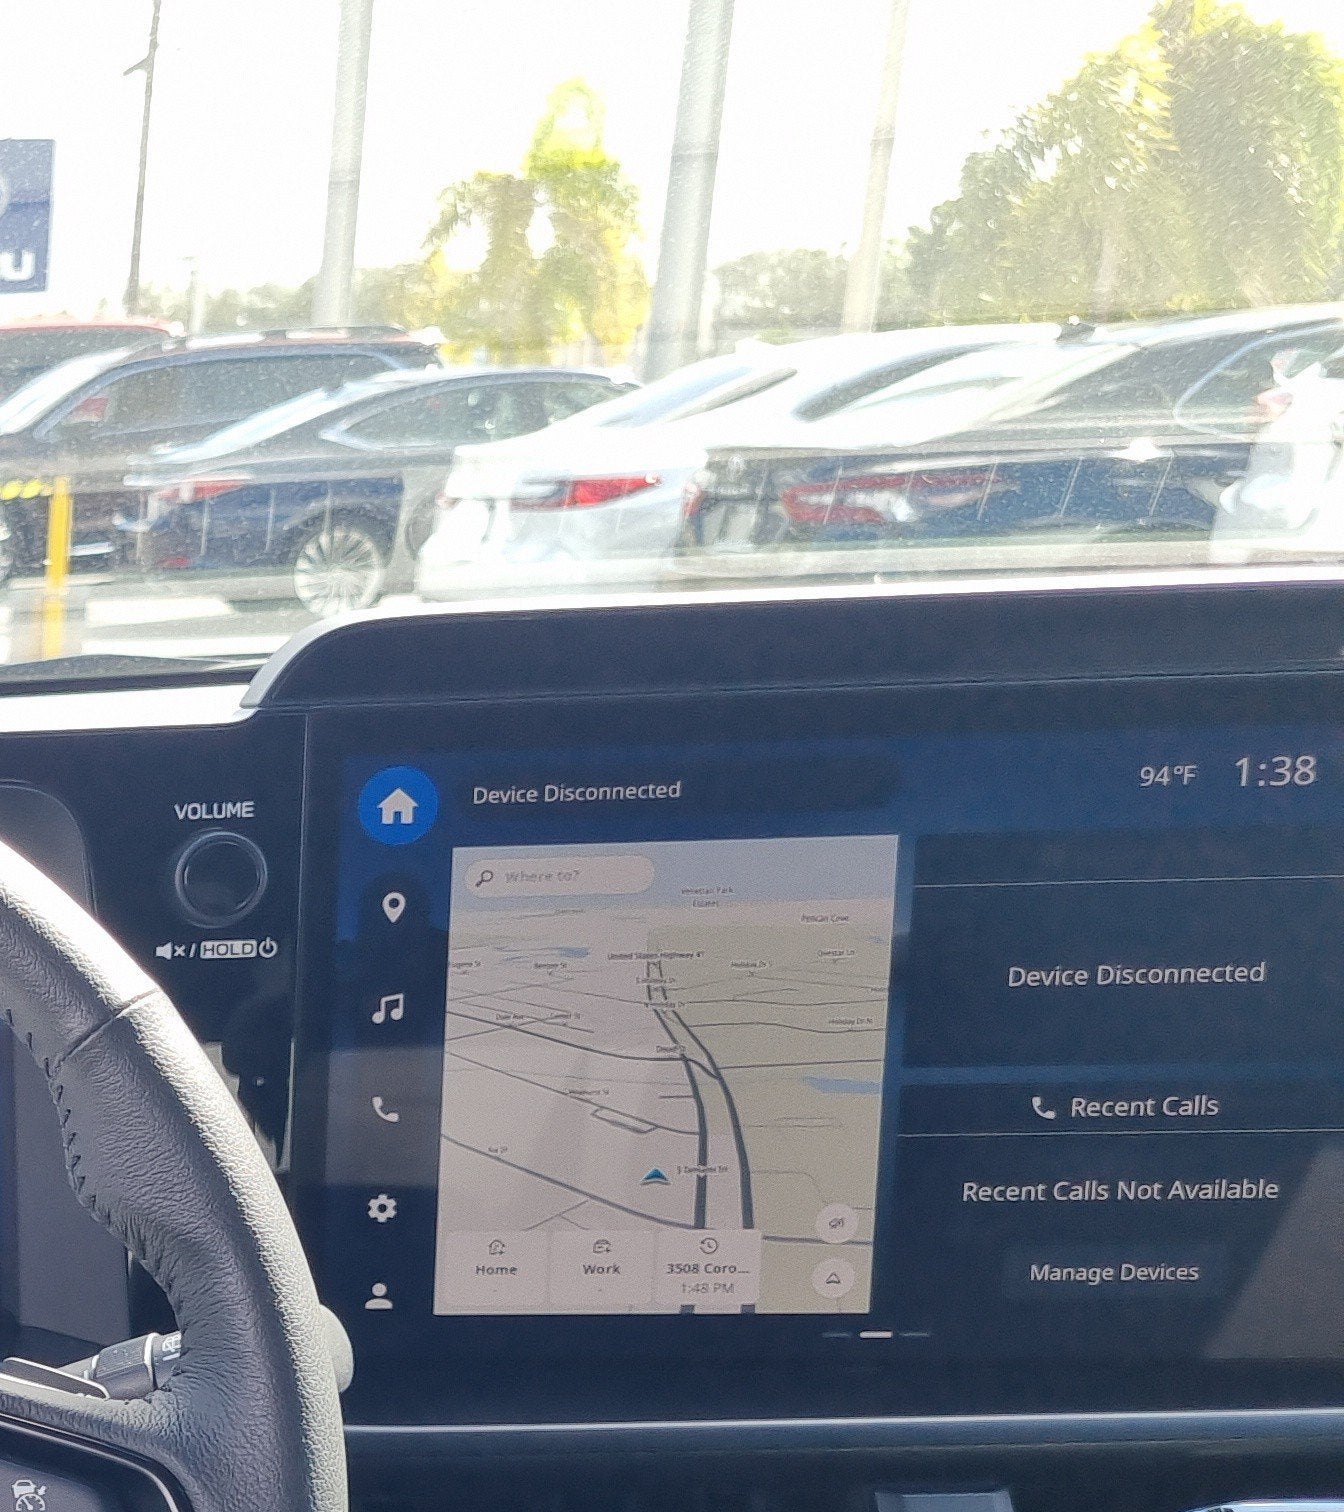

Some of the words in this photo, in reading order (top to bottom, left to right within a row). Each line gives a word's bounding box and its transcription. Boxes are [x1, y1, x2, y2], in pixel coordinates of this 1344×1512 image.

[1140, 765, 1198, 787] 94°F
[1234, 755, 1317, 787] 1:38
[473, 784, 538, 806] Device
[543, 780, 682, 803] Disconnected
[174, 801, 255, 820] VOLUME
[505, 870, 553, 884] Where
[557, 869, 582, 883] to?
[203, 942, 256, 957] HOLD
[1008, 966, 1088, 987] Device
[1096, 962, 1267, 985] Disconnected
[1071, 1096, 1155, 1118] Recent
[1162, 1095, 1220, 1116] Calls
[962, 1181, 1046, 1202] Recent
[1052, 1180, 1109, 1201] Calls
[1116, 1180, 1162, 1200] Not
[1167, 1178, 1280, 1199] Available
[475, 1264, 519, 1276] Home
[582, 1263, 621, 1275] Work
[667, 1263, 700, 1275] 3508
[1030, 1264, 1114, 1285] Manage
[1120, 1263, 1200, 1281] Devices
[713, 1282, 735, 1294] PM
